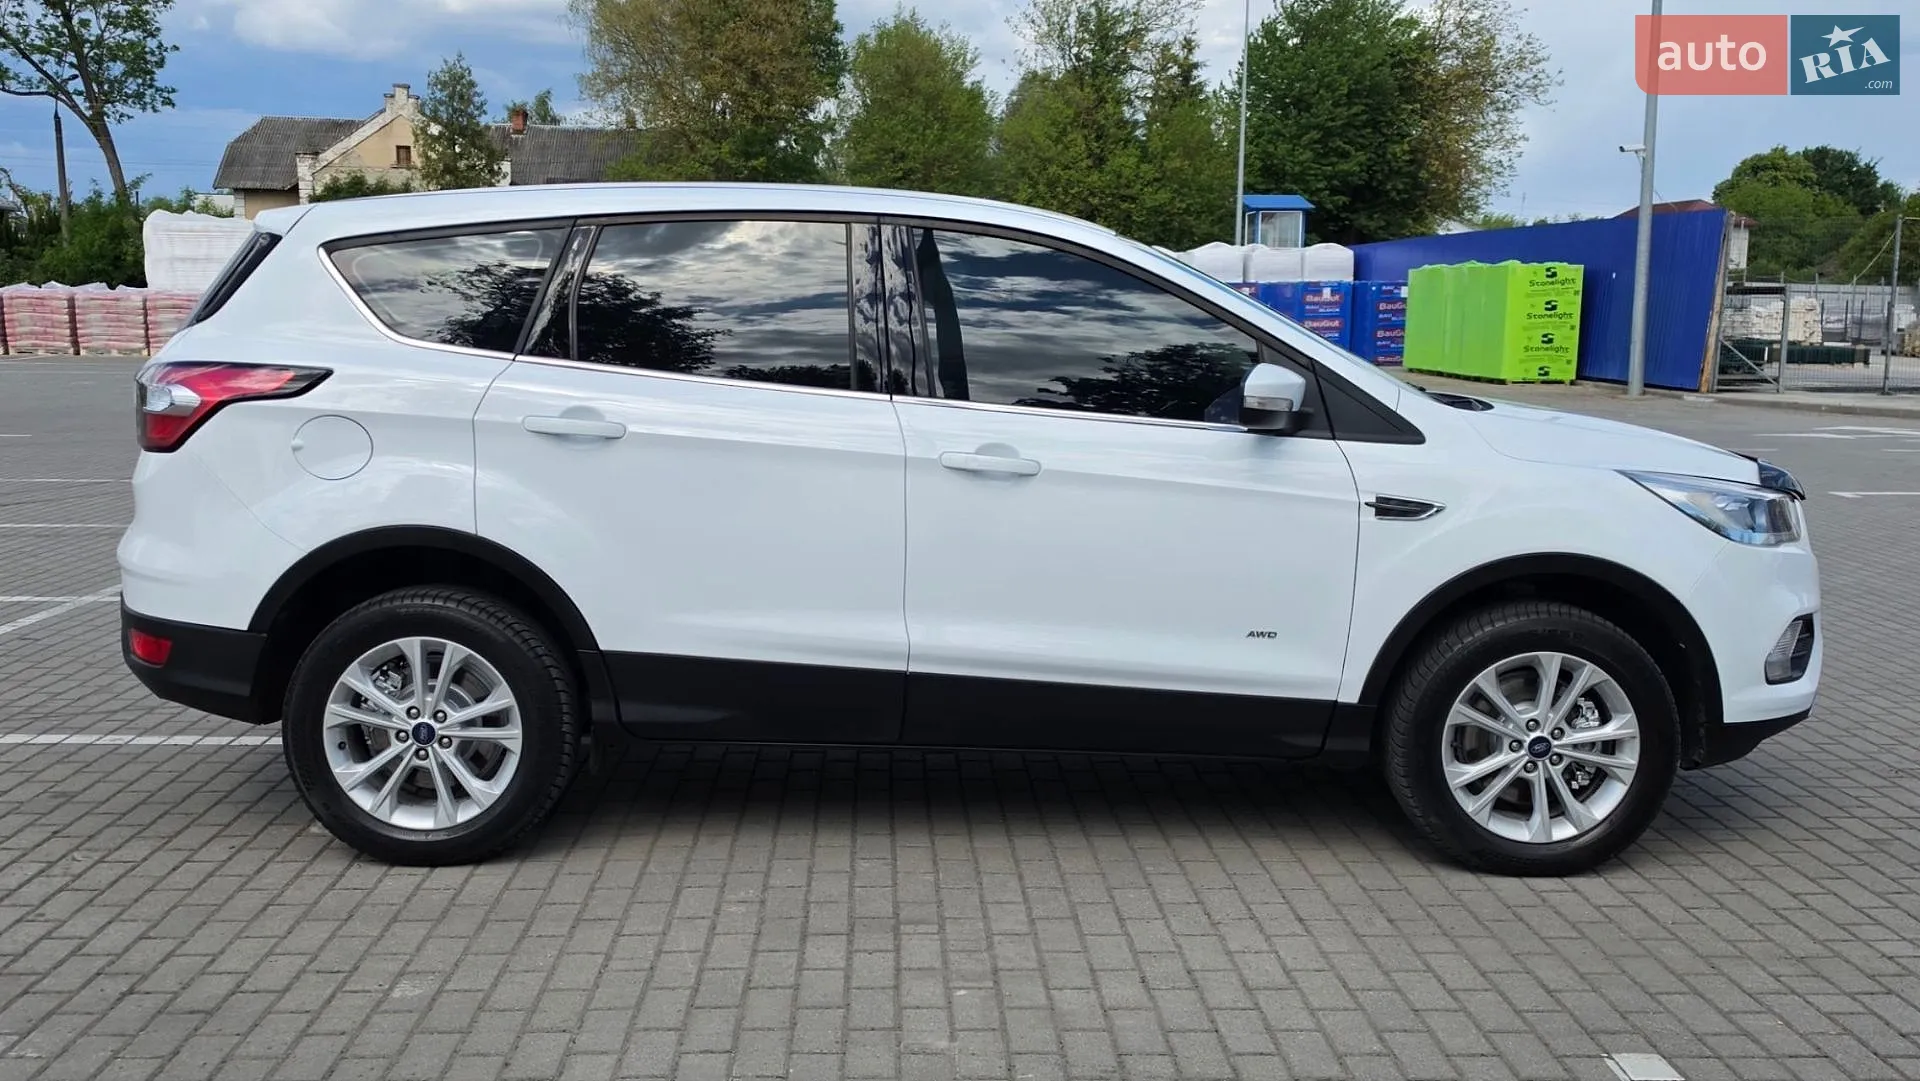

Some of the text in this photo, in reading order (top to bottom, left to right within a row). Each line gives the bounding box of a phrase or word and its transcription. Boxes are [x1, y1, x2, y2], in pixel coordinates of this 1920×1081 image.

[1528, 277, 1577, 287] Stonelight
[1526, 312, 1573, 320] Stonelight
[1523, 345, 1570, 353] Stonelight
[1246, 630, 1278, 639] AWD
